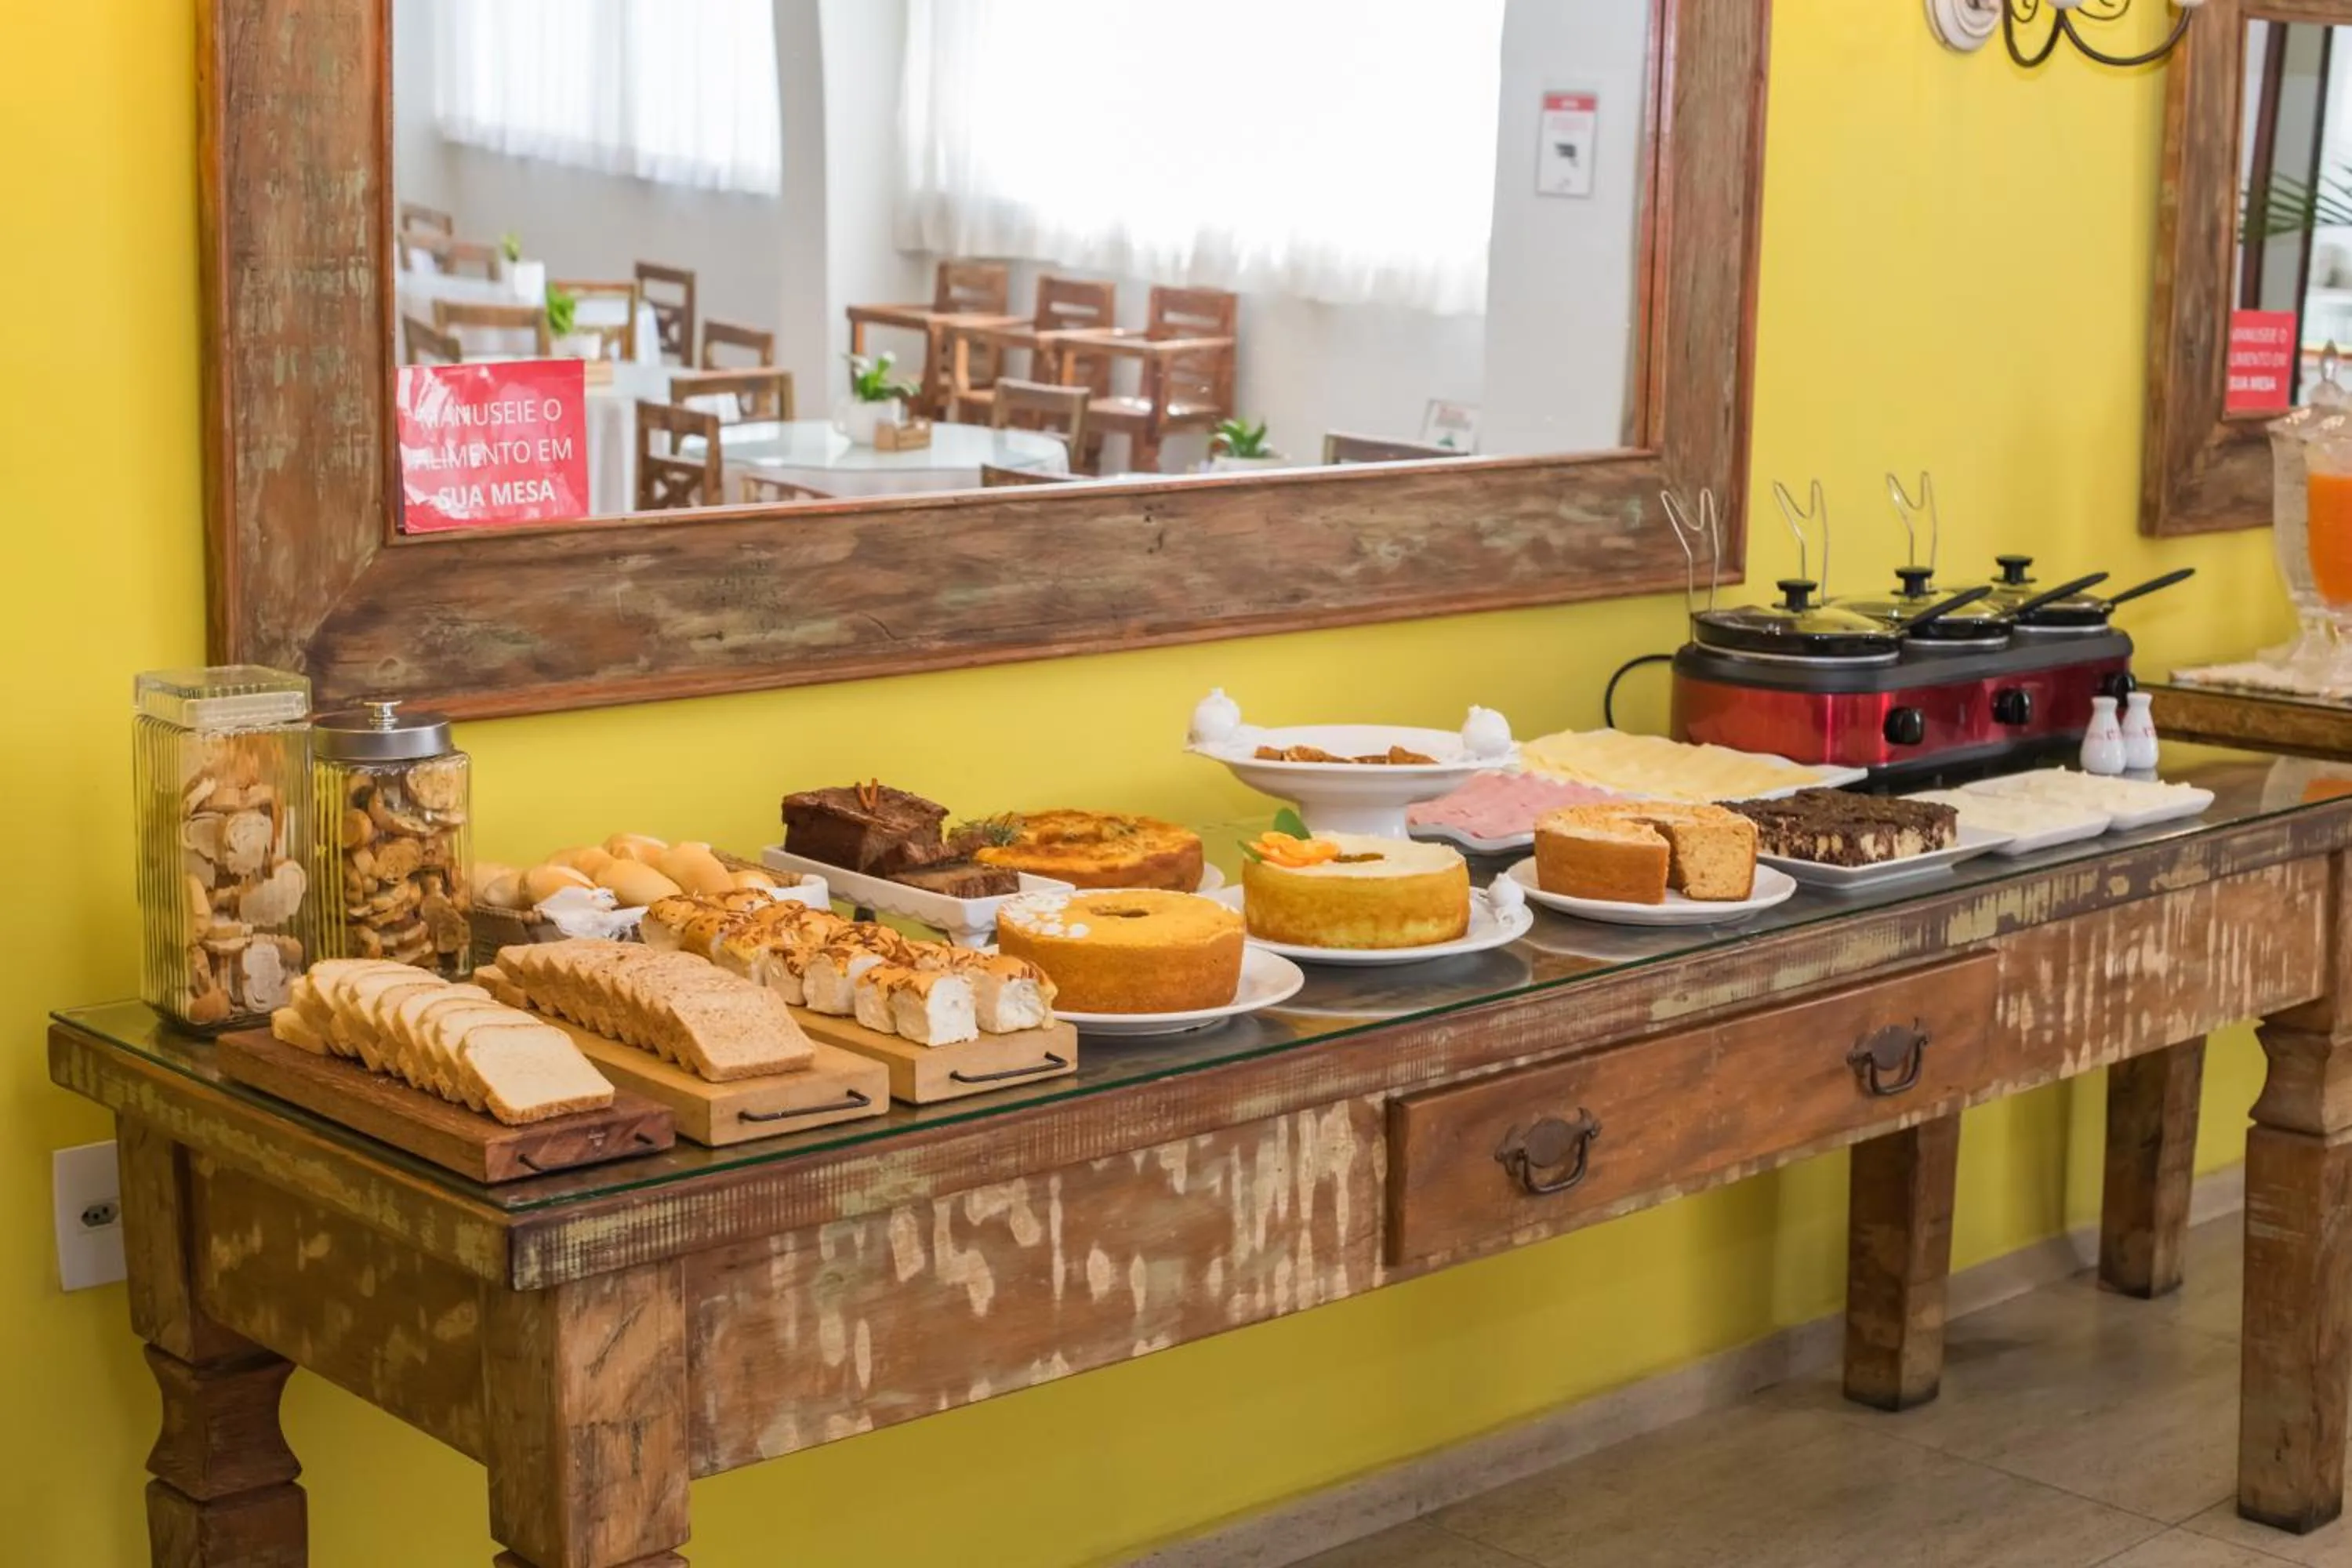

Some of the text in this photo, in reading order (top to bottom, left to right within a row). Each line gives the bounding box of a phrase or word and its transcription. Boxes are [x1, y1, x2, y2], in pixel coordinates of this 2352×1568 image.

[543, 397, 562, 422] O
[539, 437, 572, 462] EM
[437, 477, 556, 509] SUA MESA
